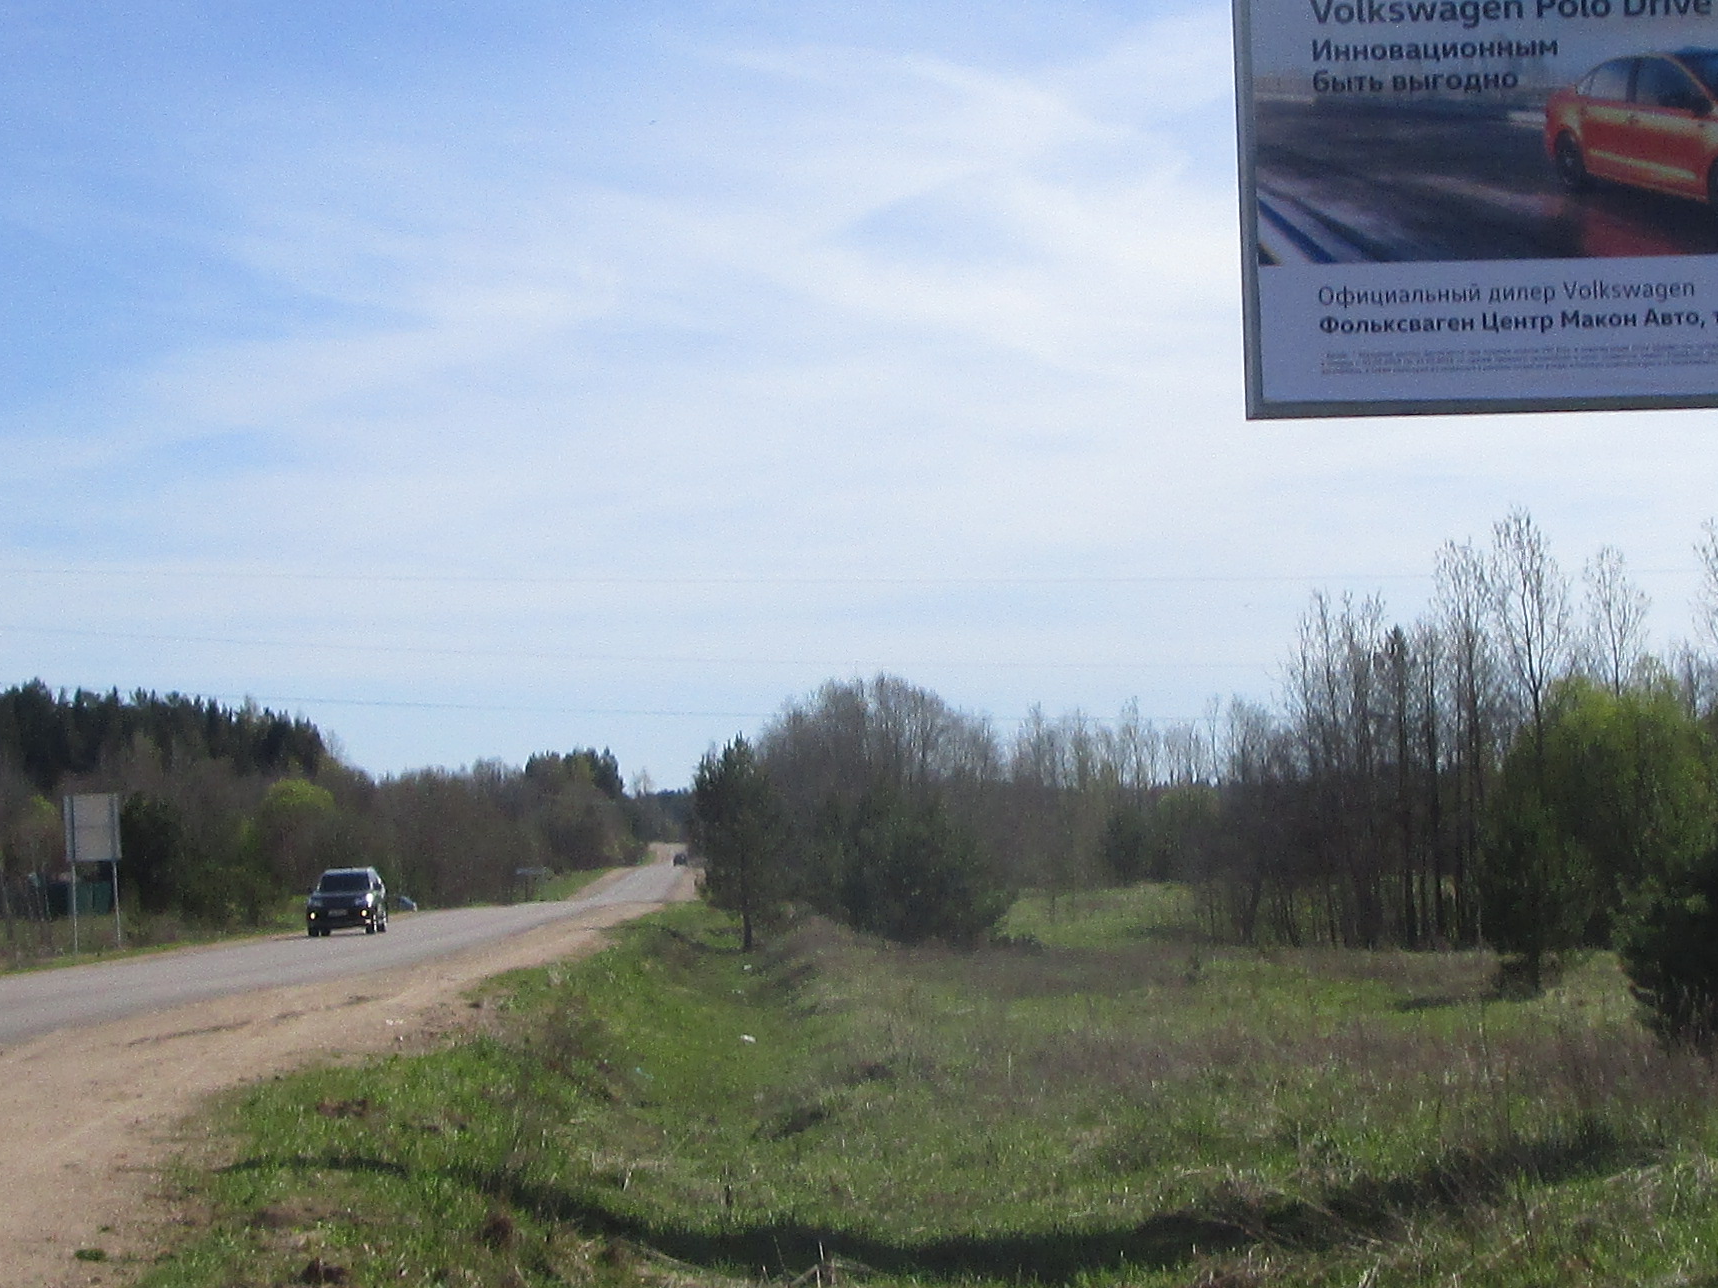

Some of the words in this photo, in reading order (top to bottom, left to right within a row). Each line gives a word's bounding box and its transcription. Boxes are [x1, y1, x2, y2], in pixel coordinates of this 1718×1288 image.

[1311, 38, 1559, 62] Инновационным
[1312, 69, 1384, 93] быть
[1392, 70, 1519, 93] выгодно
[1318, 283, 1481, 309] Официальный
[1487, 285, 1557, 305] дилер
[1563, 279, 1696, 303] Volkswagen
[1319, 315, 1475, 334] Фольксваген
[1482, 312, 1554, 334] Центр
[1560, 309, 1638, 329] Макон
[1644, 307, 1706, 329] Авто,
